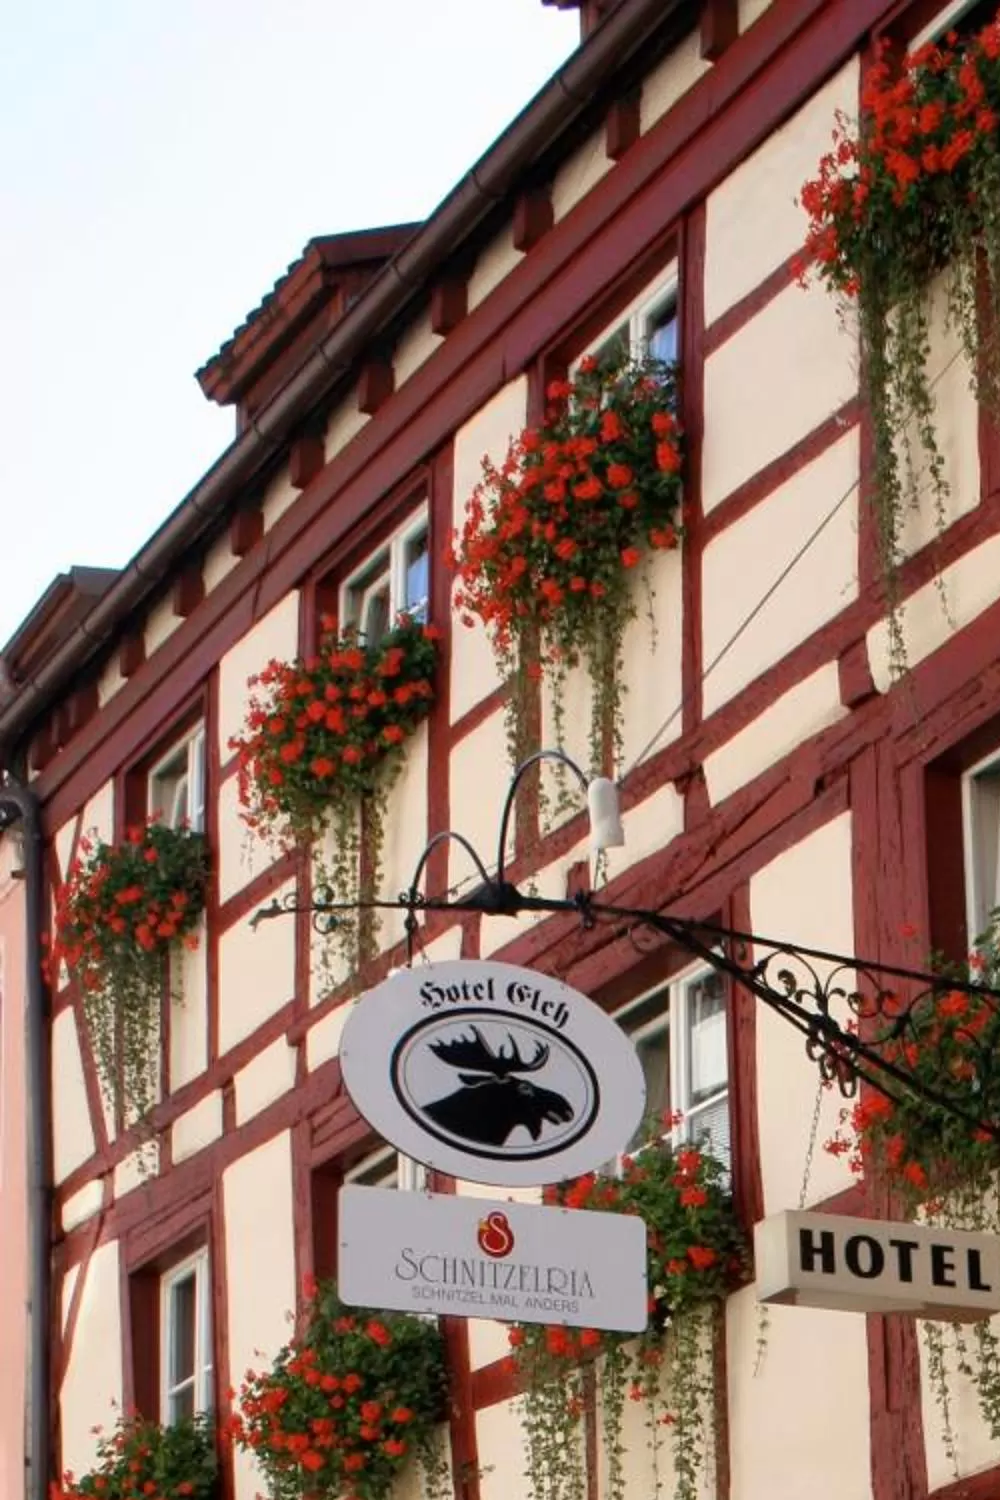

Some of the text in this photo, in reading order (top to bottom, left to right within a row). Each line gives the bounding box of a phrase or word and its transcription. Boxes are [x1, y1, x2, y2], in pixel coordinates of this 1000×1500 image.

[419, 978, 570, 1029] Hotel Elch
[799, 1228, 992, 1292] HOTEL
[524, 1297, 579, 1314] ANDERS
